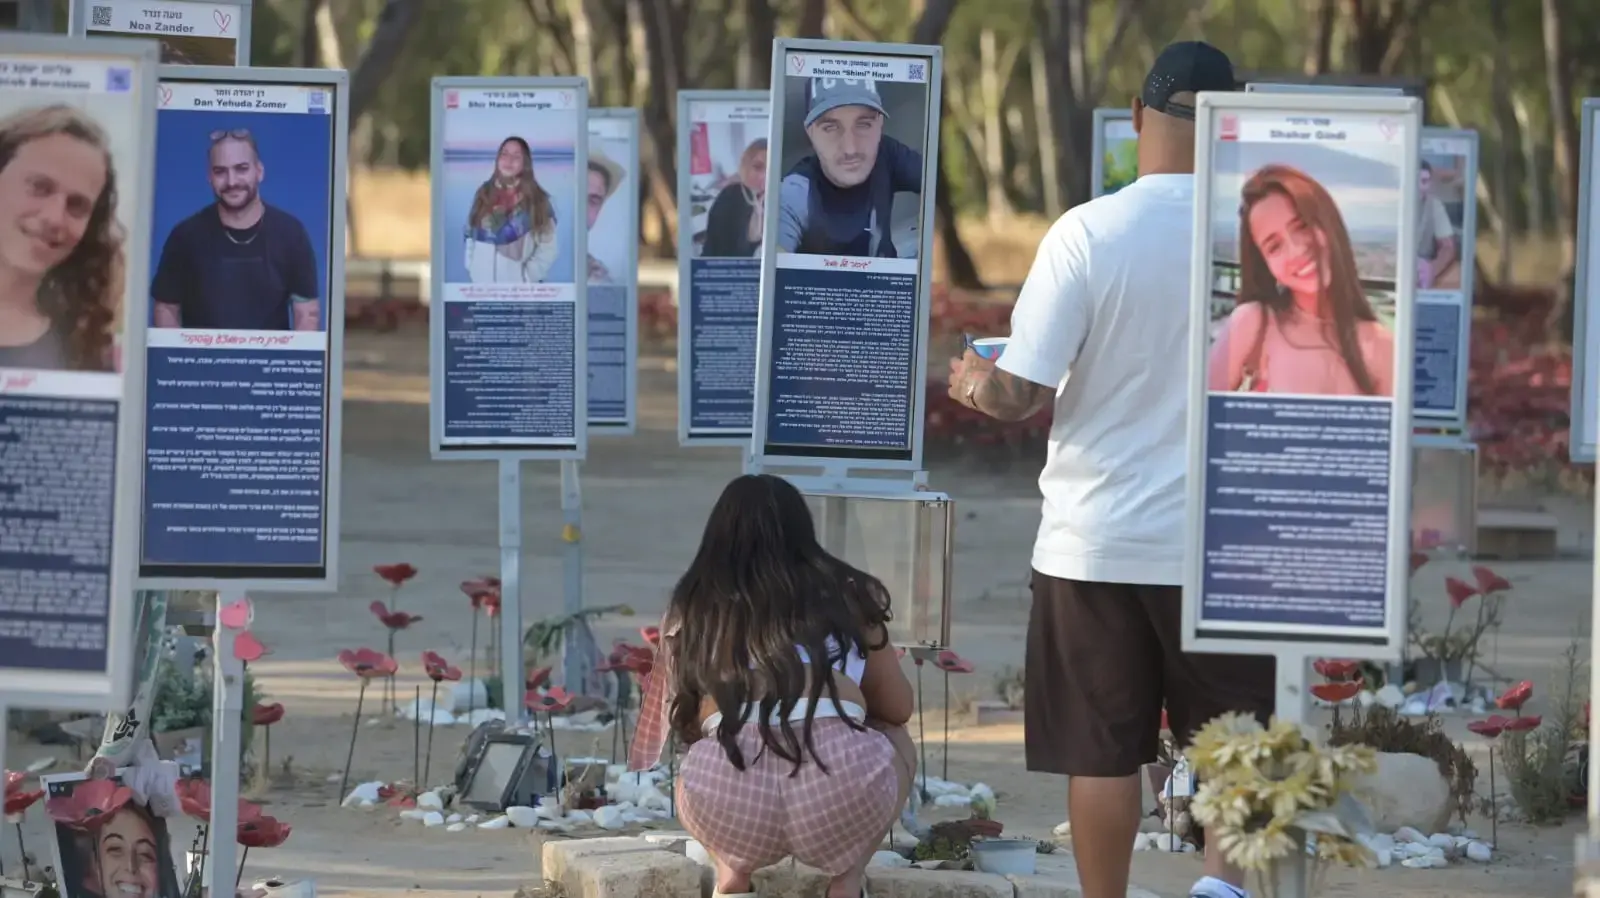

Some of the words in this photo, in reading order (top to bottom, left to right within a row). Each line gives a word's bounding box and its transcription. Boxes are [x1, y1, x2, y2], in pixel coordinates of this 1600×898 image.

[129, 20, 151, 30] Noa
[155, 22, 194, 33] Zander
[194, 98, 214, 106] Dan
[216, 99, 252, 108] Yehuda
[256, 100, 287, 109] Zomer
